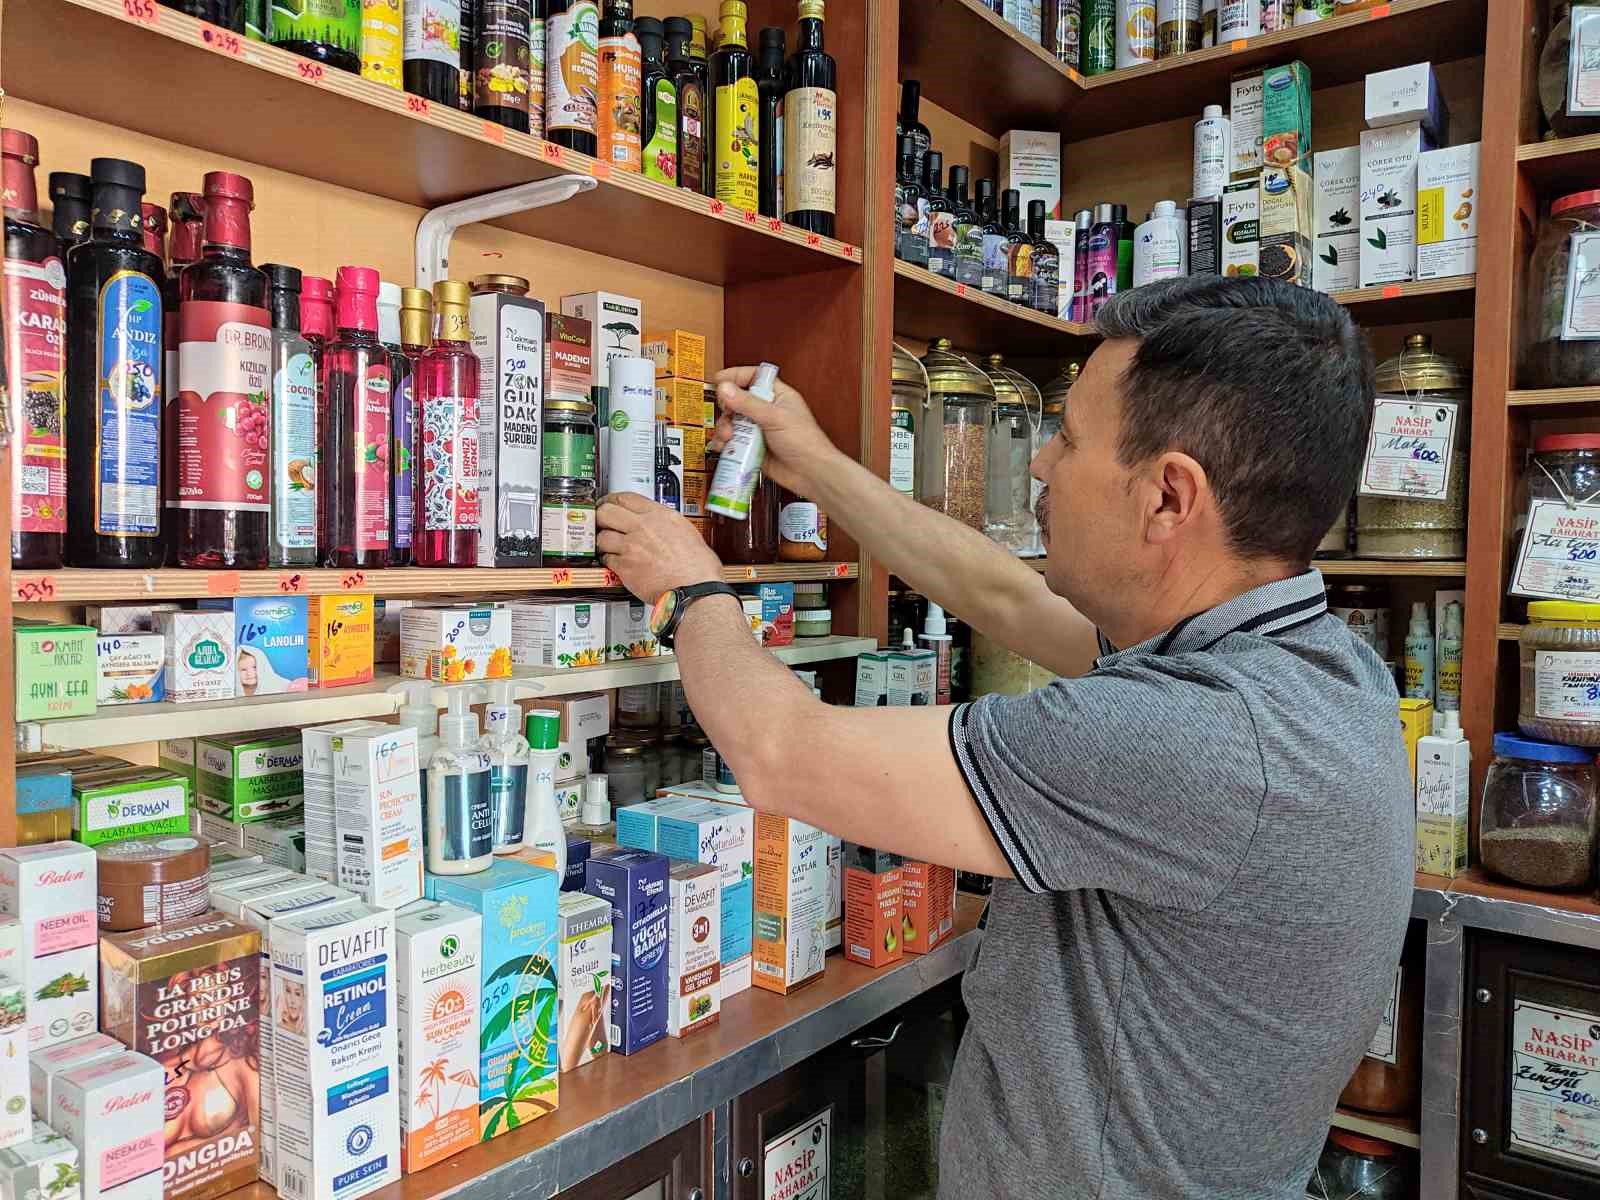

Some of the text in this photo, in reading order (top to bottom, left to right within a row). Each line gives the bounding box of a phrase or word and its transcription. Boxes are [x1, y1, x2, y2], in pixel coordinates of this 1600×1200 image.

[503, 405, 537, 423] DAK
[1395, 415, 1433, 428] NASİP
[503, 432, 538, 446] ŞURUBU
[1555, 516, 1600, 529] NASİP
[97, 640, 121, 657] 140
[122, 799, 170, 818] DERMAN
[40, 913, 89, 933] NEEM OIL
[570, 912, 611, 934] THEMRA
[632, 917, 667, 946] VÜCUT
[633, 930, 668, 959] BAKIM
[420, 952, 477, 979] Herbeauty
[157, 967, 243, 1003] LA PLUS
[323, 976, 387, 1010] RETINOL
[154, 982, 246, 1019] GRANDE
[146, 995, 251, 1040] POITRINE
[150, 1013, 249, 1056] LONG DA
[1531, 1027, 1593, 1052] NASİP
[1524, 1041, 1600, 1068] BAHARAT
[105, 1136, 156, 1163] NEEM OIL
[164, 1129, 254, 1182] ONGDA
[337, 1160, 383, 1186] PURE SKIN
[774, 1149, 816, 1188] NASİP
